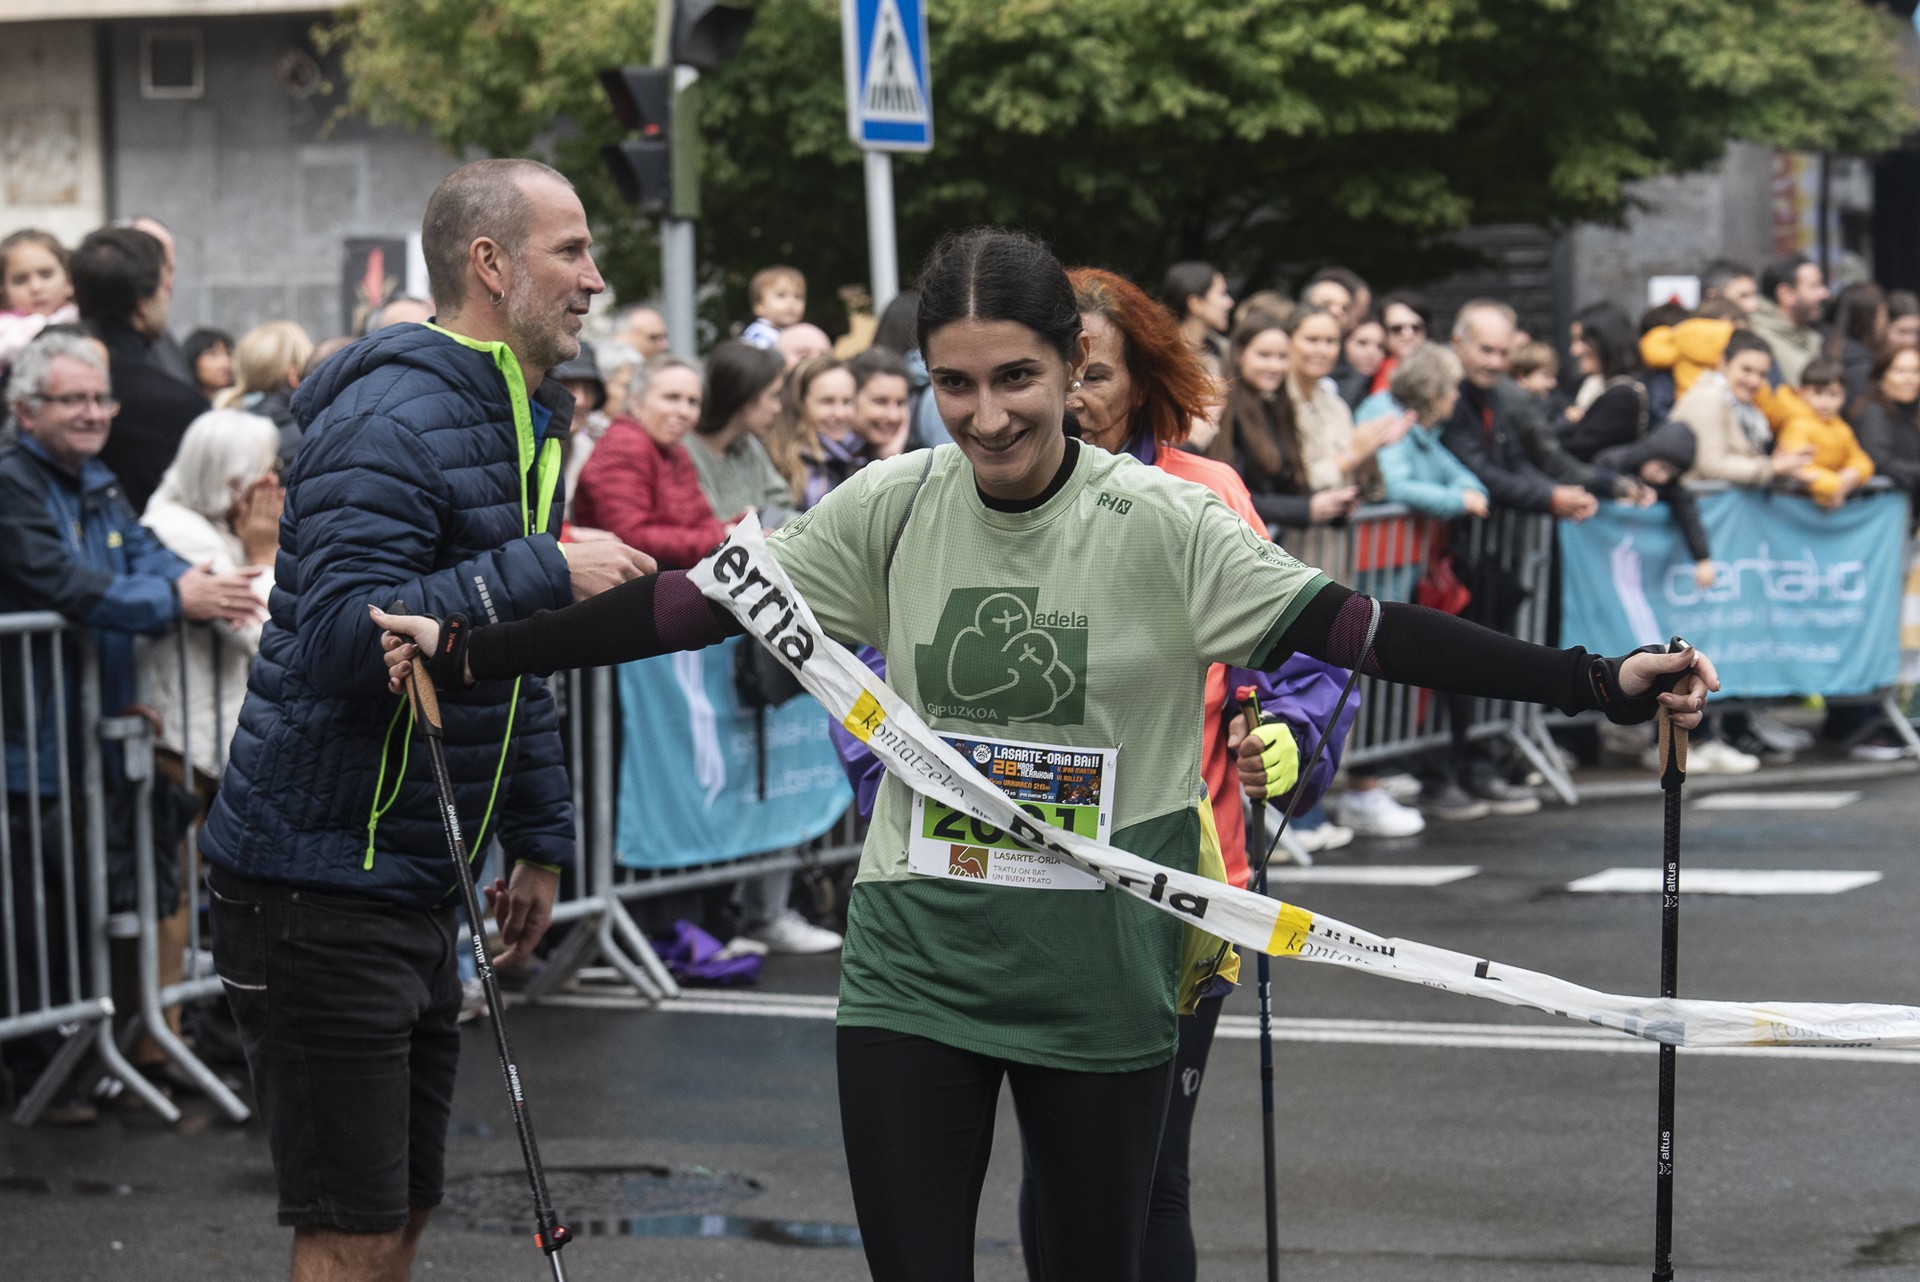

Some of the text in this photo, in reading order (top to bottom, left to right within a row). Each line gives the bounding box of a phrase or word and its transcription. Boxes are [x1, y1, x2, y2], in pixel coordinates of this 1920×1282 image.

[1034, 610, 1088, 627] adela
[926, 703, 998, 719] GIPUZKOA
[993, 851, 1061, 865] LASARTE-ORIA
[993, 865, 1047, 876] TRATU ON BAT
[1666, 862, 1677, 892] altus
[1005, 874, 1025, 882] BUEN
[1027, 876, 1052, 885] TRATO
[472, 934, 486, 964] altus
[1660, 1131, 1671, 1160] altus
